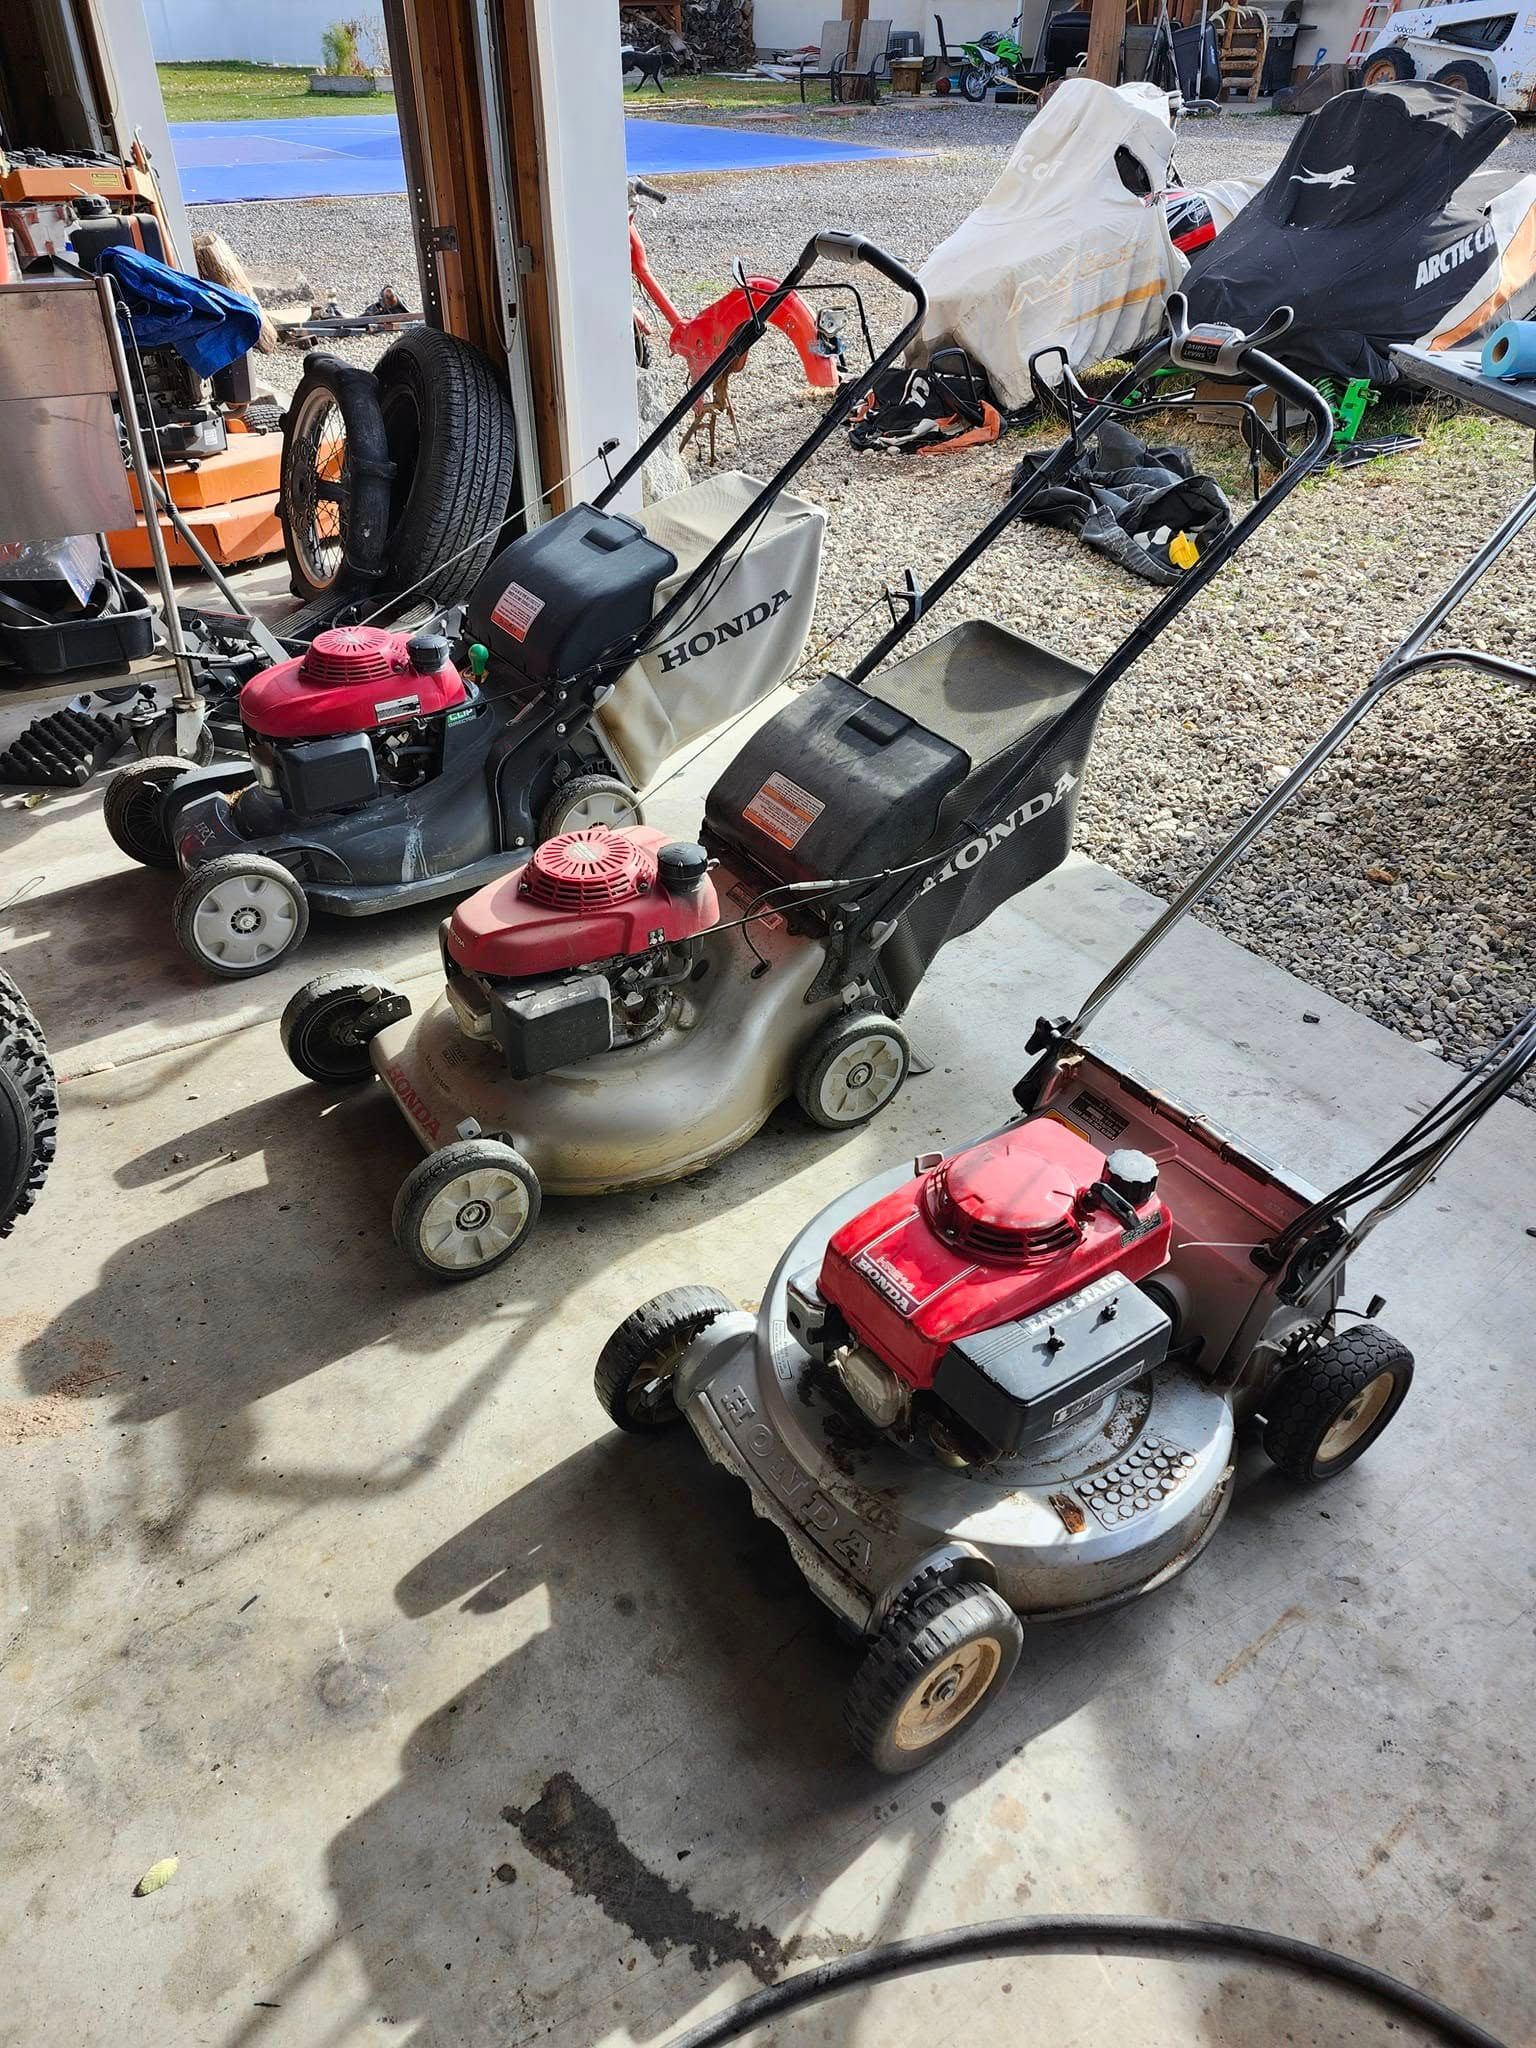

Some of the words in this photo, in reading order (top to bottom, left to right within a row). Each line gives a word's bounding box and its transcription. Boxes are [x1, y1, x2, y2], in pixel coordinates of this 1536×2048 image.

[1415, 233, 1474, 290] ARCTIC
[1475, 221, 1495, 253] CA
[658, 589, 792, 673] HONDA
[386, 1064, 441, 1141] HONDA
[856, 1258, 910, 1312] HONDA
[1025, 1300, 1073, 1332] EASY
[1071, 1272, 1127, 1312] START
[721, 1384, 873, 1576] HONDA
